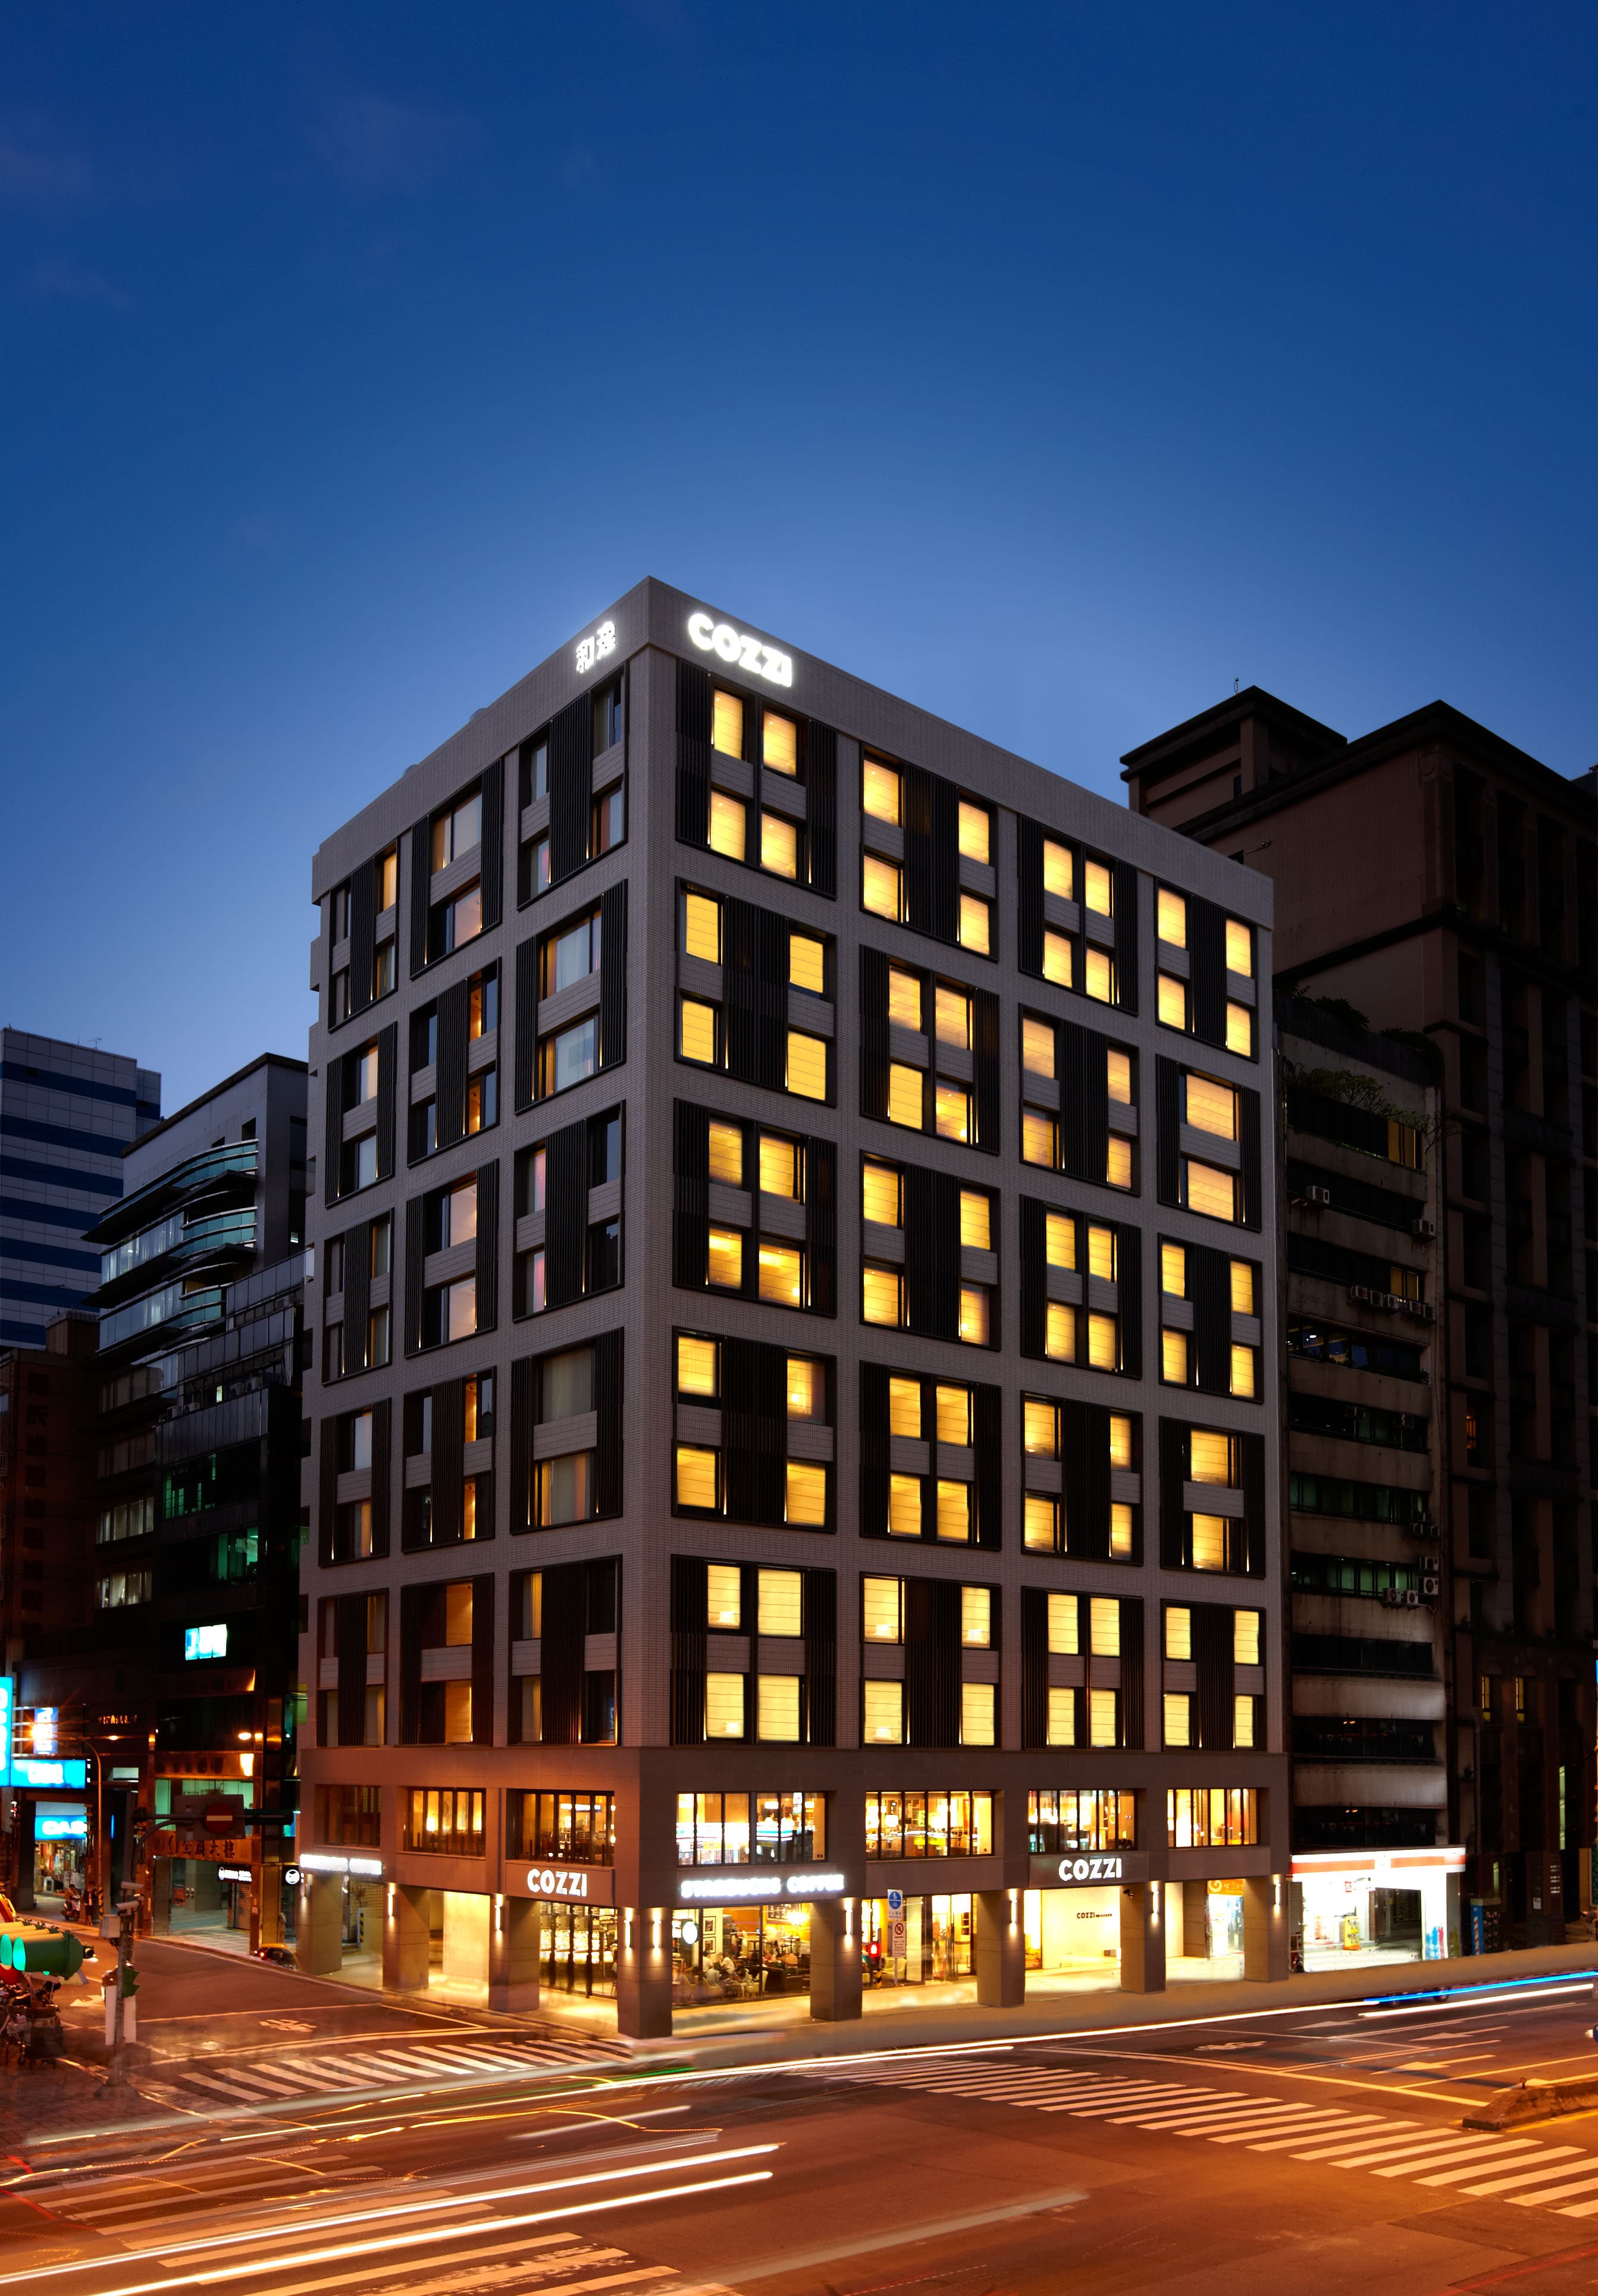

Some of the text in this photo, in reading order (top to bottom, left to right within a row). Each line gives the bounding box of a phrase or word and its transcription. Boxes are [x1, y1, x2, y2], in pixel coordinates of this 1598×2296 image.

[688, 613, 792, 688] COZZI
[528, 1869, 587, 1896] COZZI
[1058, 1858, 1122, 1881] COZZI
